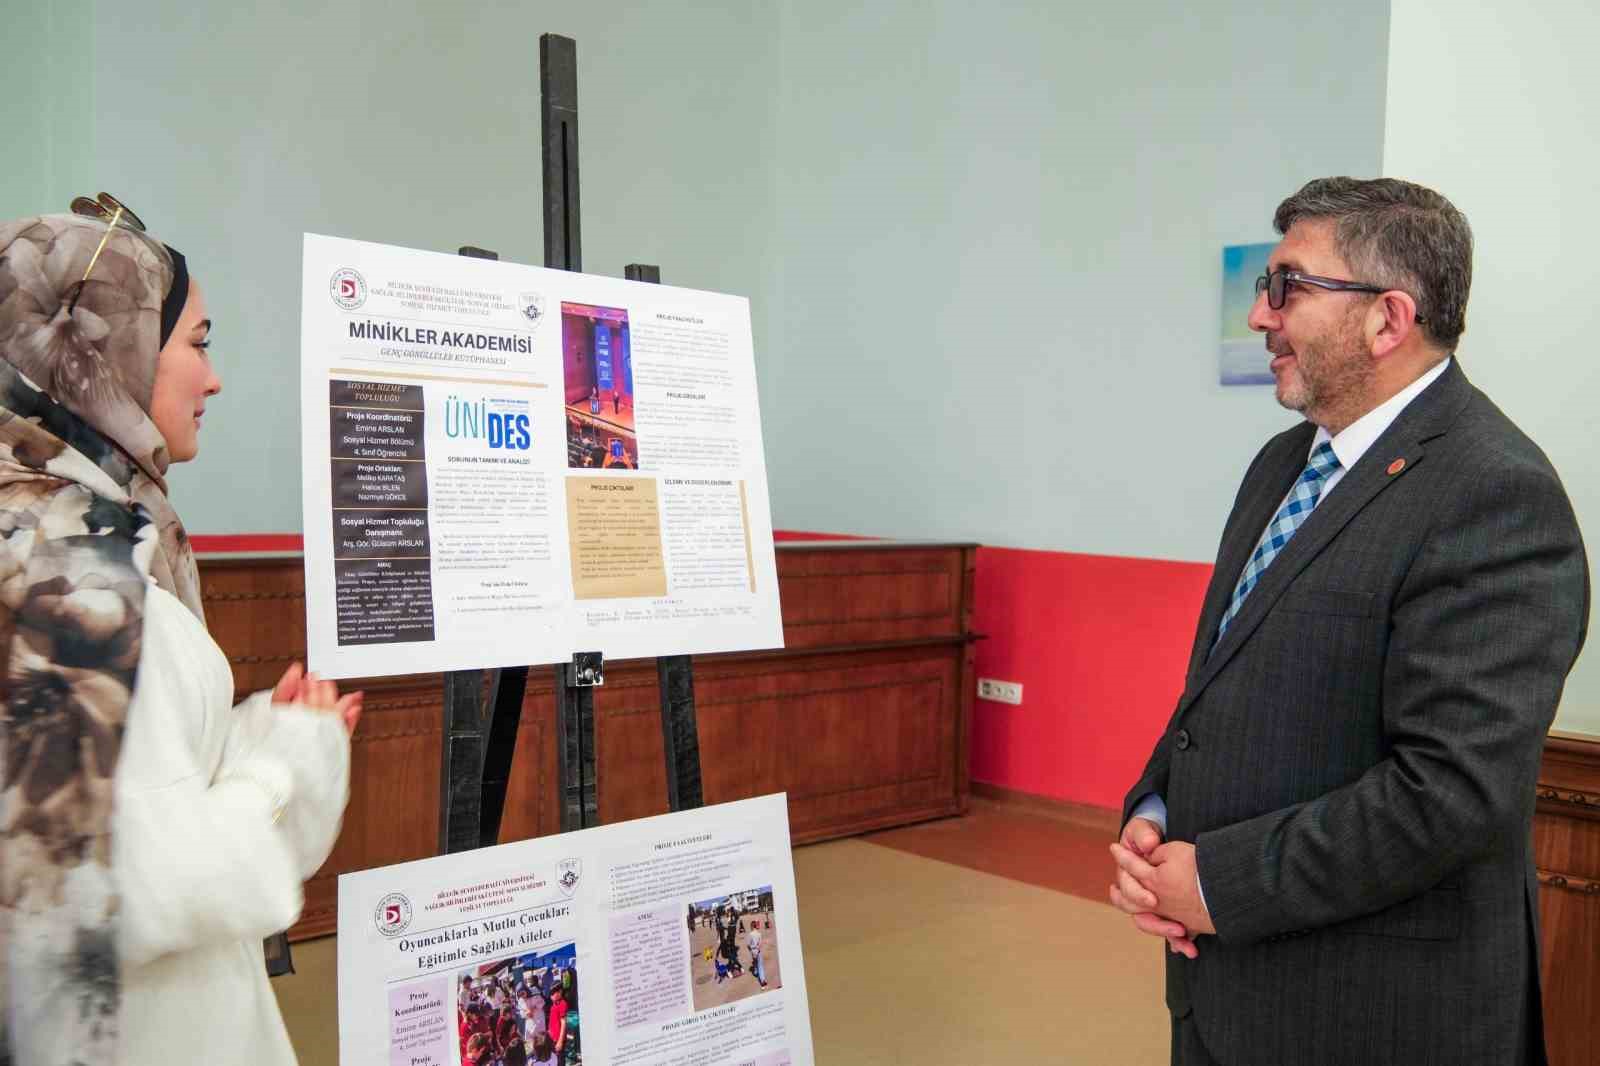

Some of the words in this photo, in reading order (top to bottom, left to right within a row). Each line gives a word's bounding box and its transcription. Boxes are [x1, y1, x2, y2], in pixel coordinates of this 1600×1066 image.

[349, 320, 438, 346] MİNİKLER
[440, 331, 533, 354] AKADEMİSİ
[346, 411, 366, 421] Proje
[355, 424, 377, 433] Emine
[377, 425, 405, 434] ARSLAN
[343, 435, 366, 445] Sosyal
[341, 518, 365, 527] Sosyal
[399, 925, 479, 953] Oyuncaklarla
[483, 918, 517, 934] Mutlu
[519, 906, 570, 927] Çocuklar;
[417, 948, 468, 970] Eğitimle
[471, 938, 515, 957] Sağlıklı
[518, 928, 553, 946] Aileler
